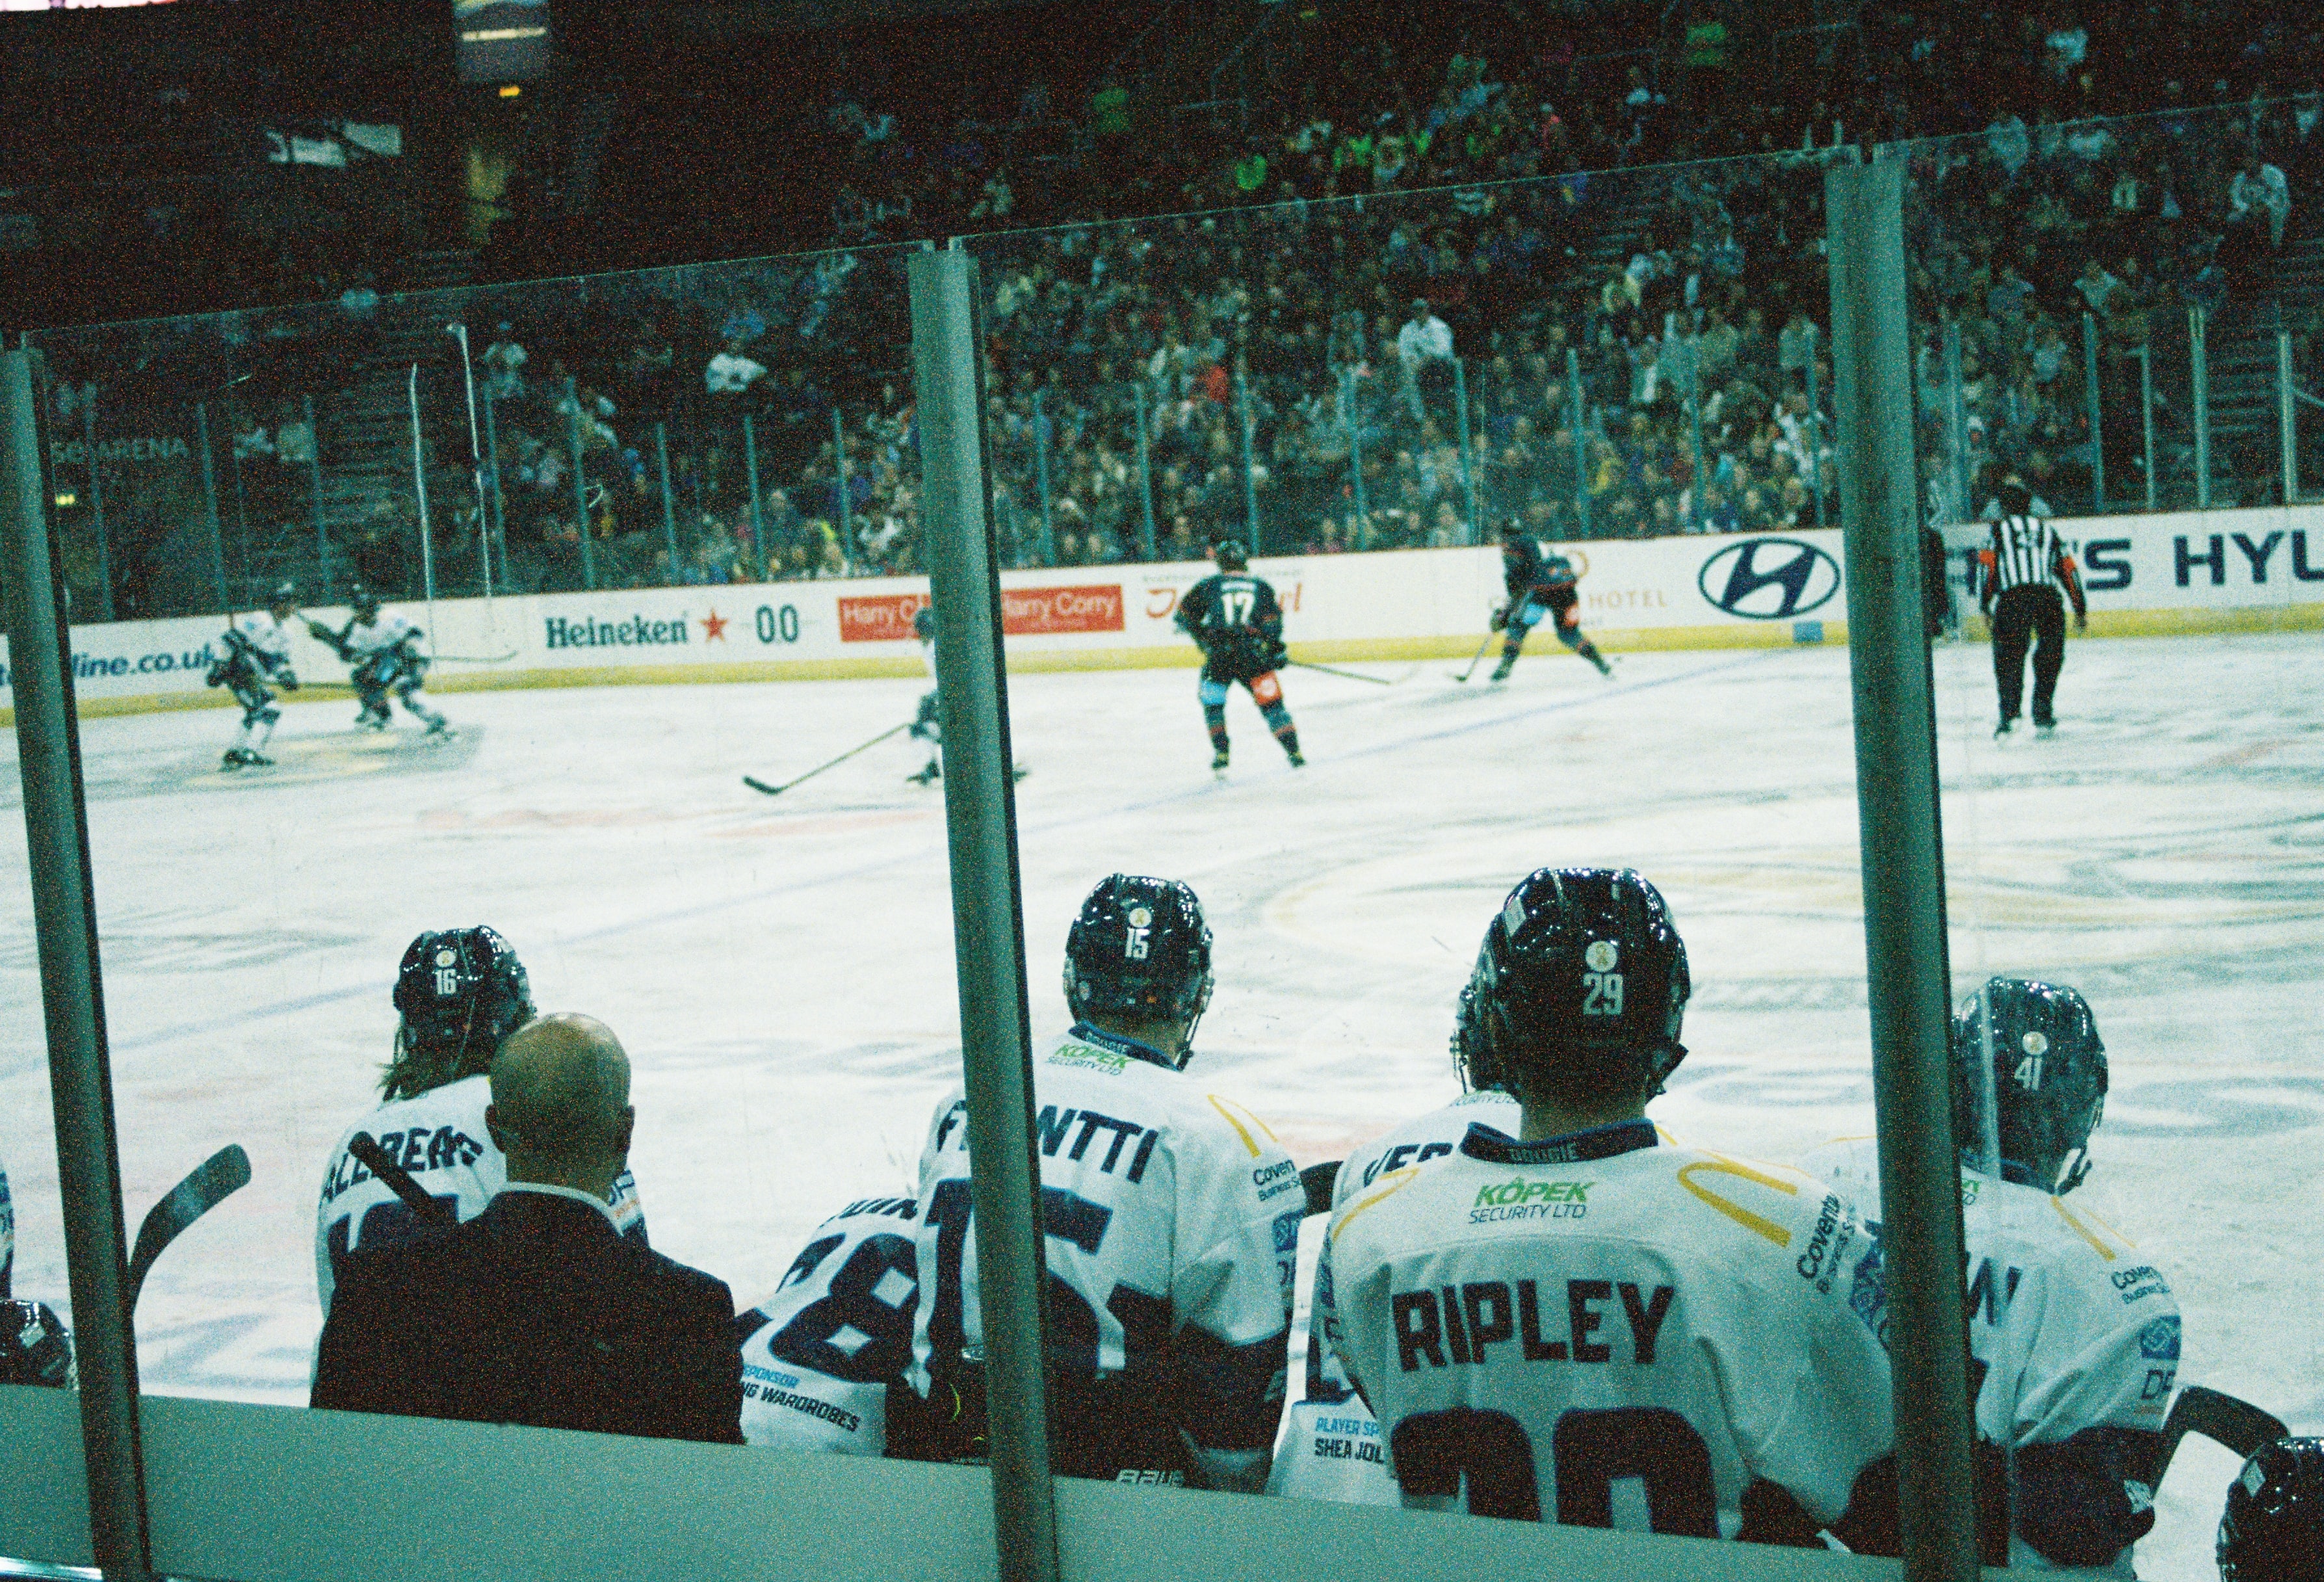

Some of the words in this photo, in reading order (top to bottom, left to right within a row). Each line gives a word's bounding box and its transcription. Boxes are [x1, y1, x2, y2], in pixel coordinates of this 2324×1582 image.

[1056, 591, 1116, 620] Corry
[1222, 593, 1255, 625] 17
[1588, 590, 1668, 609] HOTEL
[842, 601, 896, 629] Harry
[545, 616, 688, 649] Heineken
[1125, 927, 1151, 960] 15
[435, 968, 457, 995] 16
[1583, 973, 1623, 1016] 29
[2014, 1055, 2043, 1090] 41
[1469, 1205, 1551, 1224] SECURITY
[1552, 1204, 1587, 1219] LTD
[1391, 1279, 1674, 1371] RIPLEY
[761, 1386, 860, 1432] WARDROBES
[1315, 1417, 1361, 1436] PLAYER
[1314, 1438, 1352, 1459] SHEA
